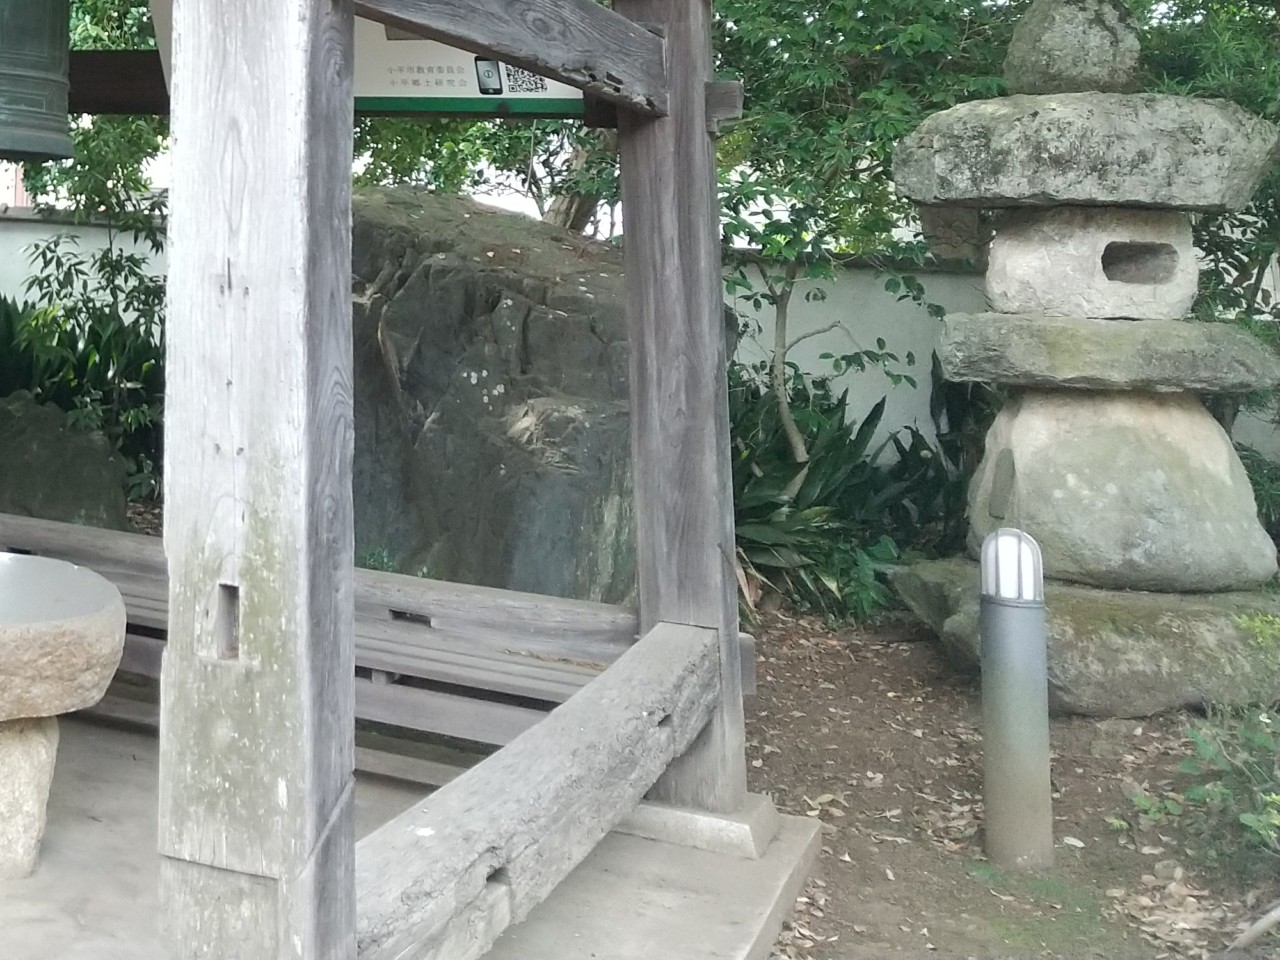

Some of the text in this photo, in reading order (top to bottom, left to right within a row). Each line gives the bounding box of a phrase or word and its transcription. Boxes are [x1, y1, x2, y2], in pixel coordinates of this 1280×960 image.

[387, 65, 465, 74] 小平市教育委員会
